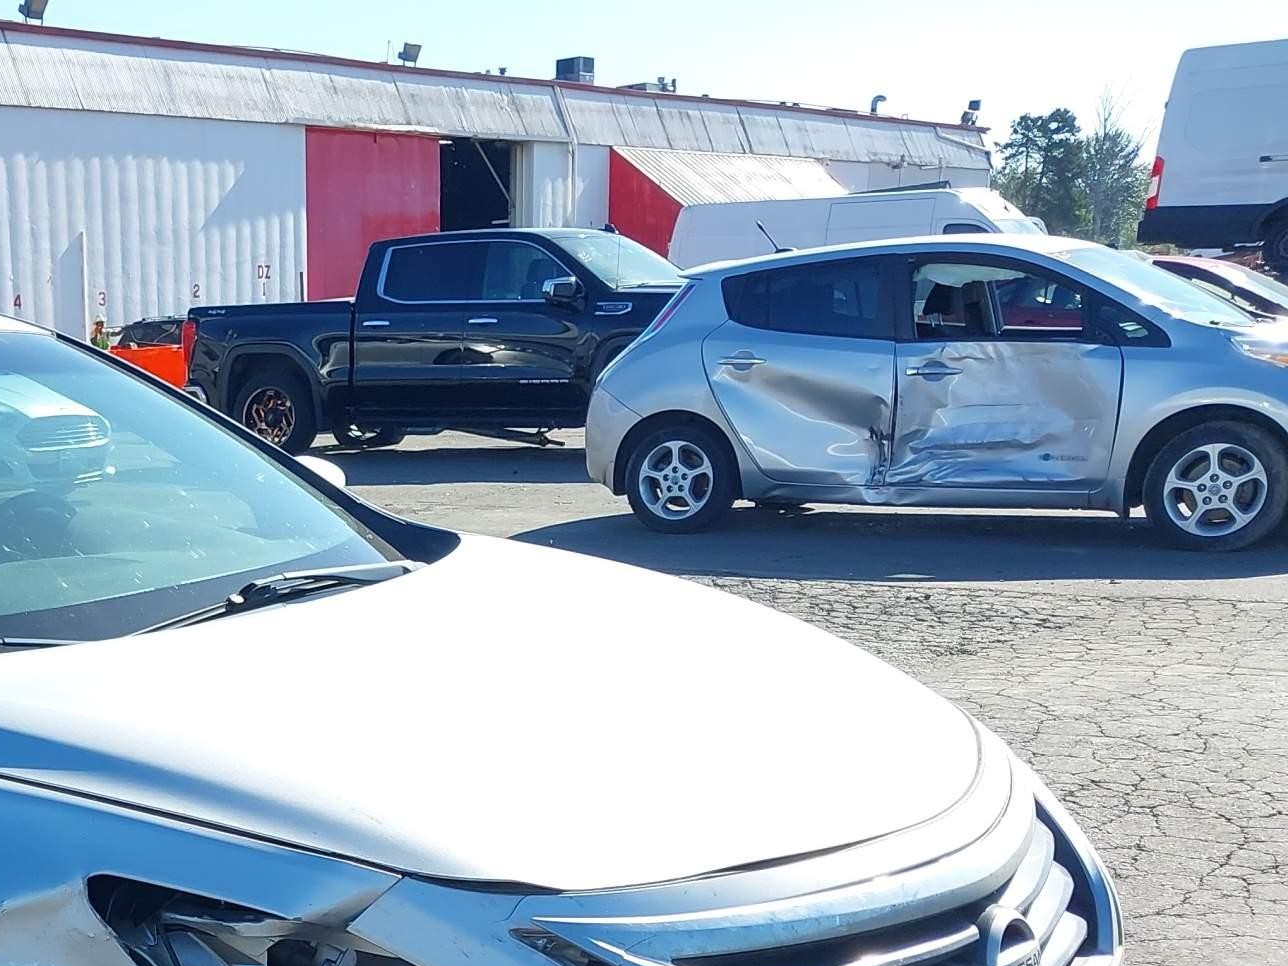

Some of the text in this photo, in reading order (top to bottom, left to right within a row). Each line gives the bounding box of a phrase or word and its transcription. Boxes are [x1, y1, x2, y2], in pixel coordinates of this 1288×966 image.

[98, 291, 106, 306] 3
[193, 283, 201, 299] 2
[13, 293, 22, 310] 4
